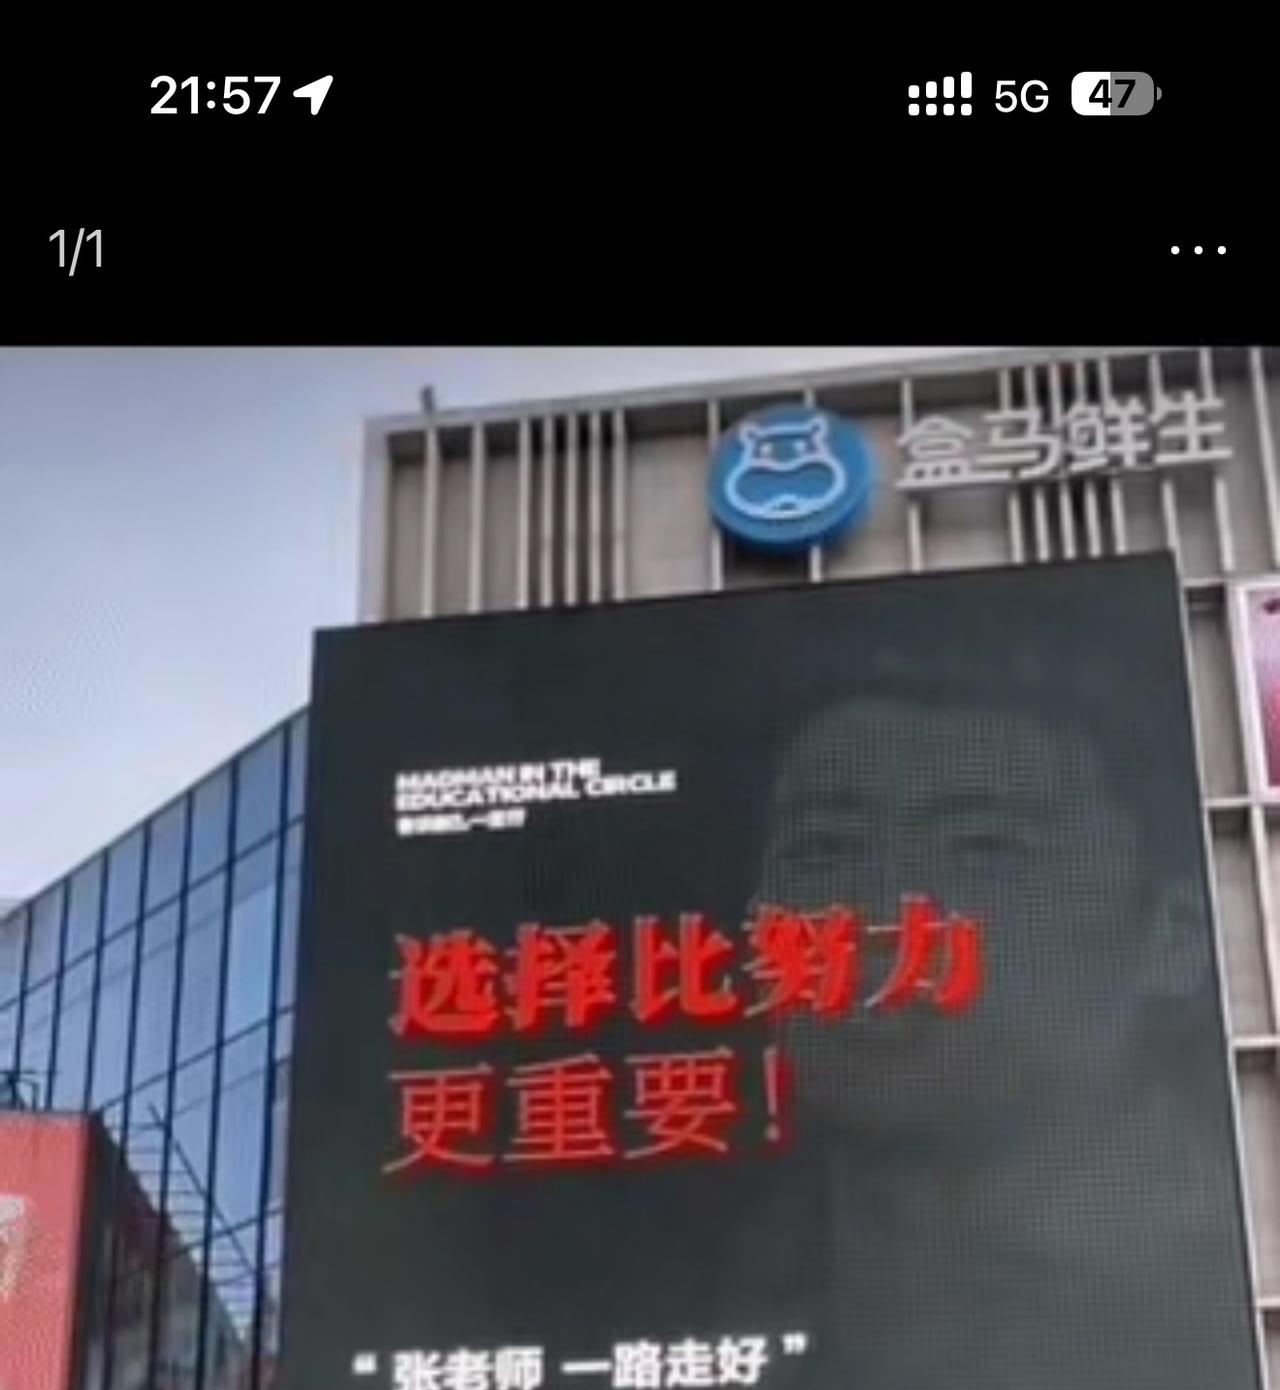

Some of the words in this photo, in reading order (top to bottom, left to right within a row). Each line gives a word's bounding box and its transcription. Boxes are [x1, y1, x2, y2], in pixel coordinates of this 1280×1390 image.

[896, 390, 1232, 489] 盒马鲜生
[396, 767, 515, 794] MADMAN
[519, 762, 545, 785] IN
[551, 757, 601, 781] THE
[396, 781, 581, 812] EDUCATIONAL
[586, 769, 677, 797] CIRCLE
[387, 893, 984, 1036] 选择比努力
[383, 1044, 794, 1175] 更重要！
